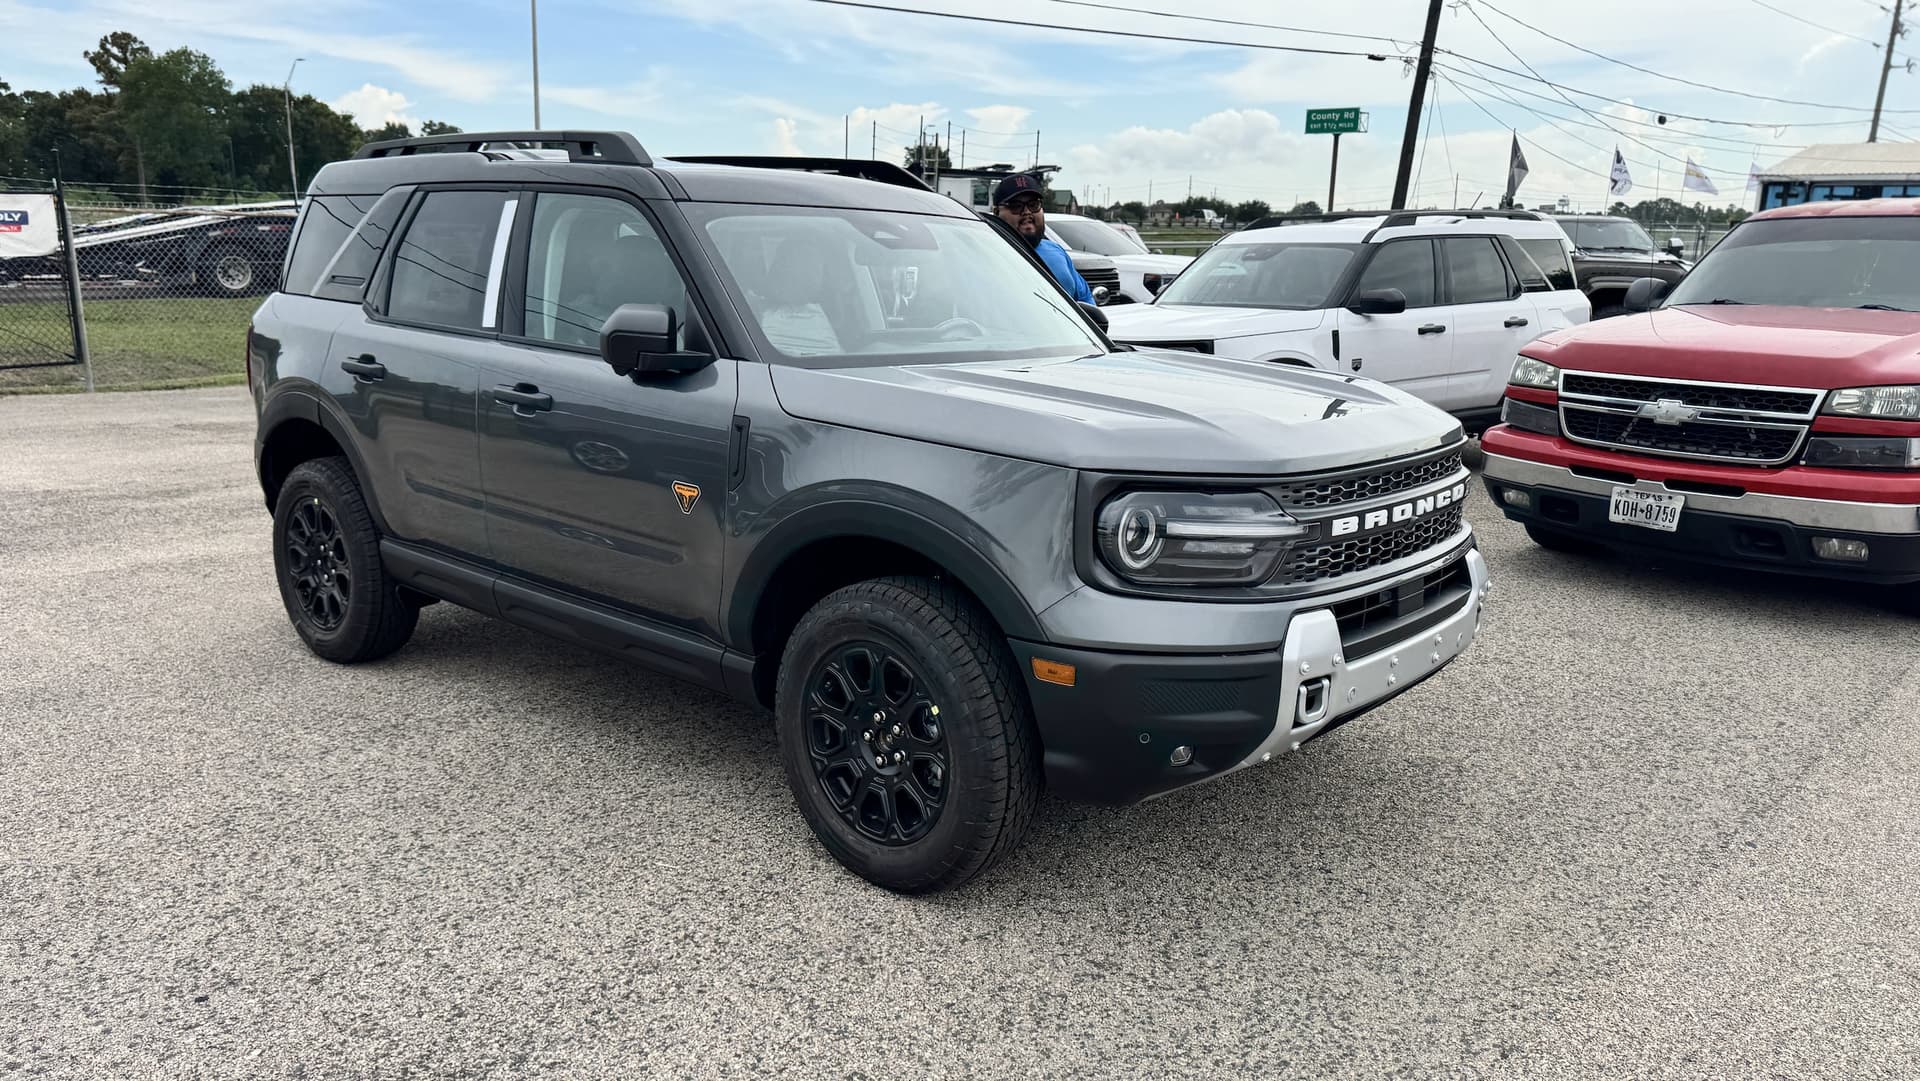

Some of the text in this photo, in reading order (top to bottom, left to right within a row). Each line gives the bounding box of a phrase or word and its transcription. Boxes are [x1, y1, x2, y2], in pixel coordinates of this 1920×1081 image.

[1311, 111, 1355, 121] County Rd
[1634, 491, 1663, 502] TEXAS
[1331, 483, 1465, 536] BRONCO
